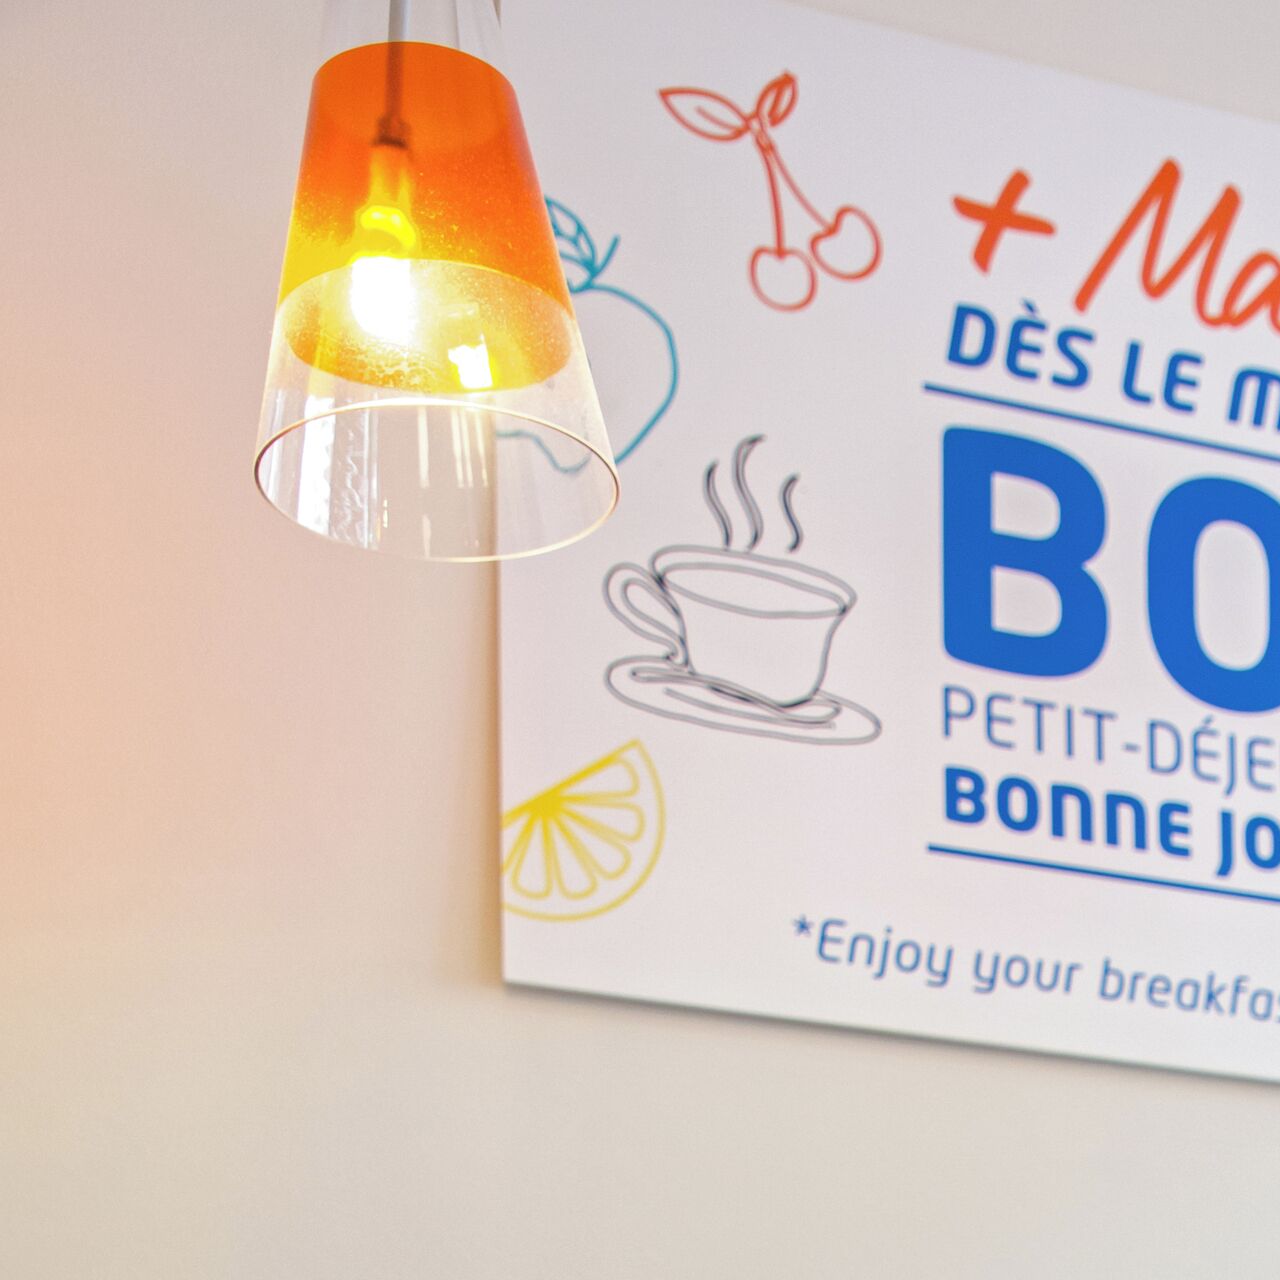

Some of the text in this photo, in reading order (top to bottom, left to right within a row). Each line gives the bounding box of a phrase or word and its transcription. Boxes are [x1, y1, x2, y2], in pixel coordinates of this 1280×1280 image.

[946, 300, 1096, 389] DÈS
[1121, 340, 1204, 413] LE
[943, 764, 1193, 859] BONNE
[972, 950, 1081, 994] your
